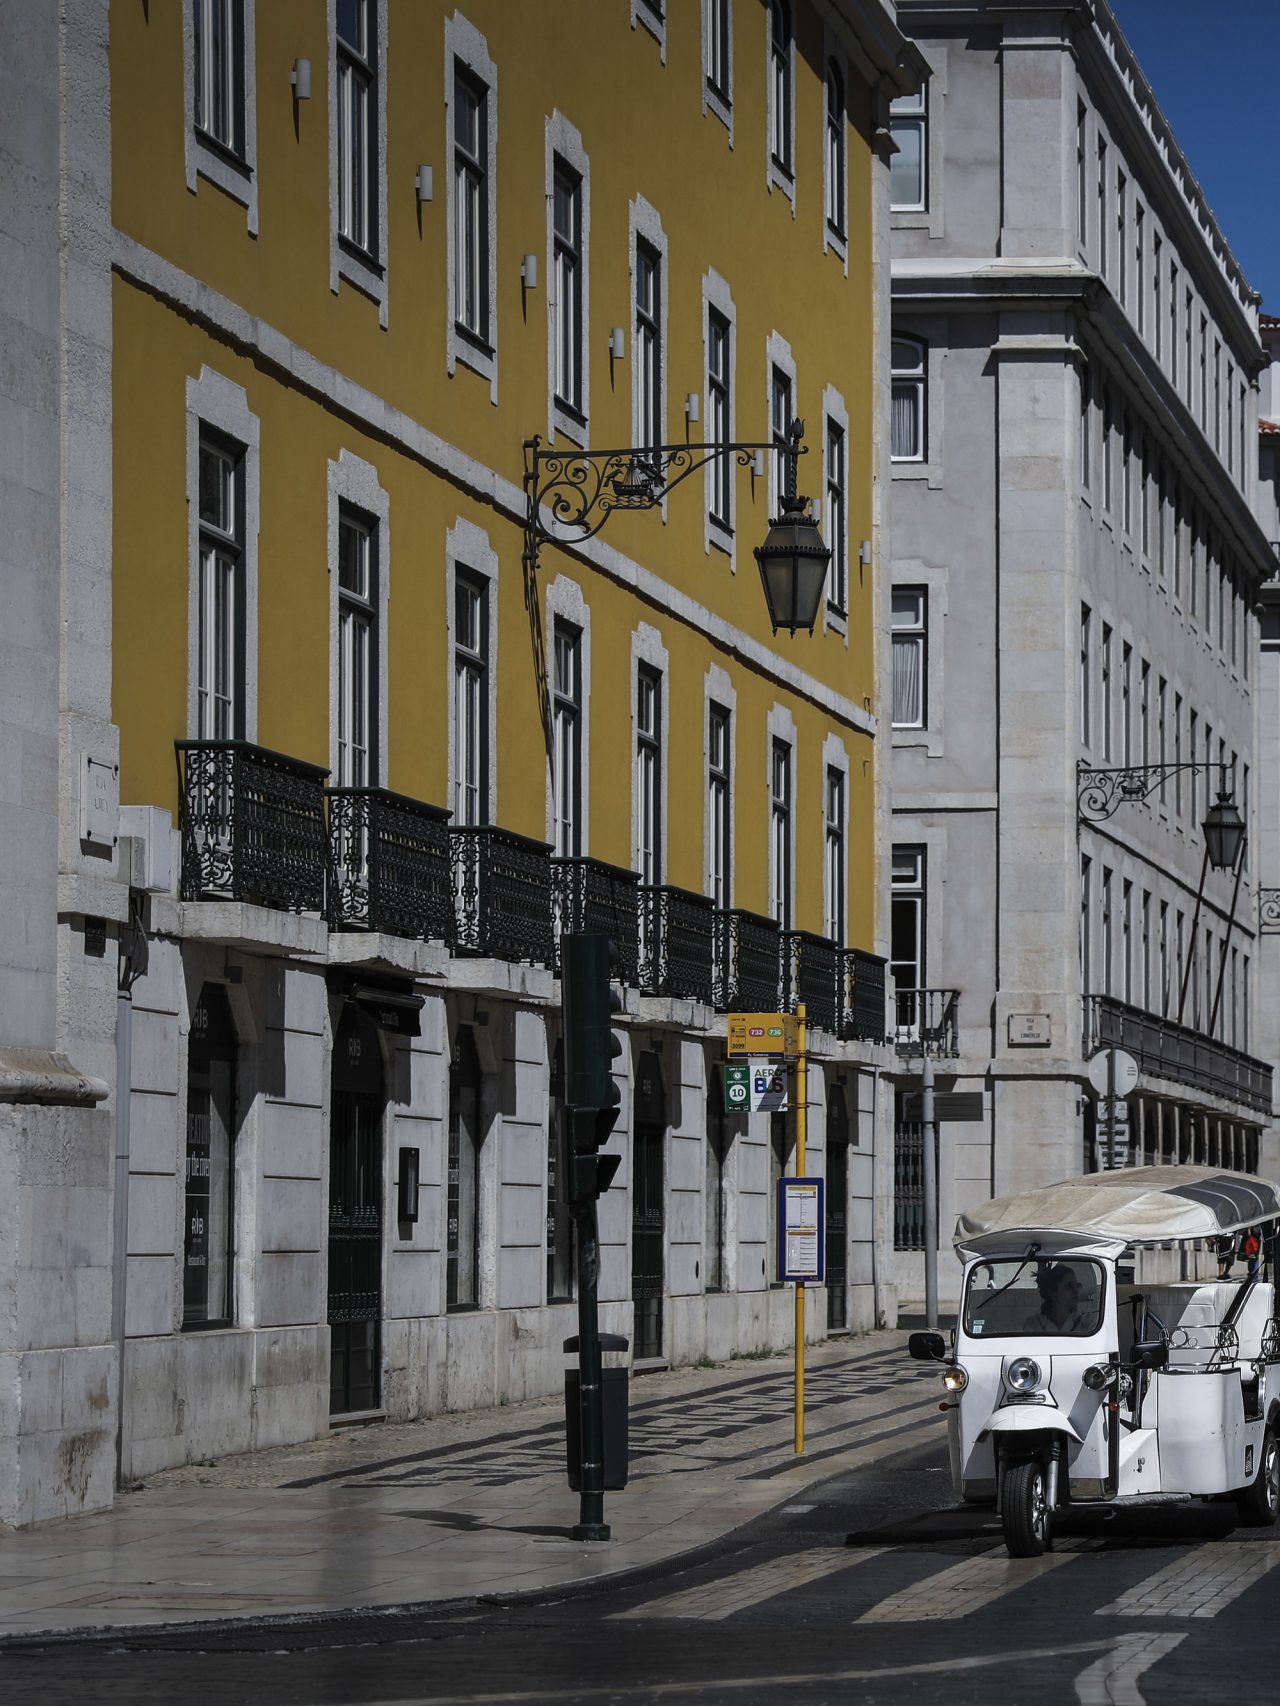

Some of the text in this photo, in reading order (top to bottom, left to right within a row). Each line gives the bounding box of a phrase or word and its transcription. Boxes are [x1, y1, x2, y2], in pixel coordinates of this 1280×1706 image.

[194, 1005, 208, 1029] RIB
[754, 1068, 783, 1077] AERO
[732, 1088, 744, 1097] 10
[754, 1077, 784, 1093] BUS
[188, 1113, 209, 1144] EATIN
[200, 1152, 209, 1176] rive
[191, 1212, 204, 1235] RIB
